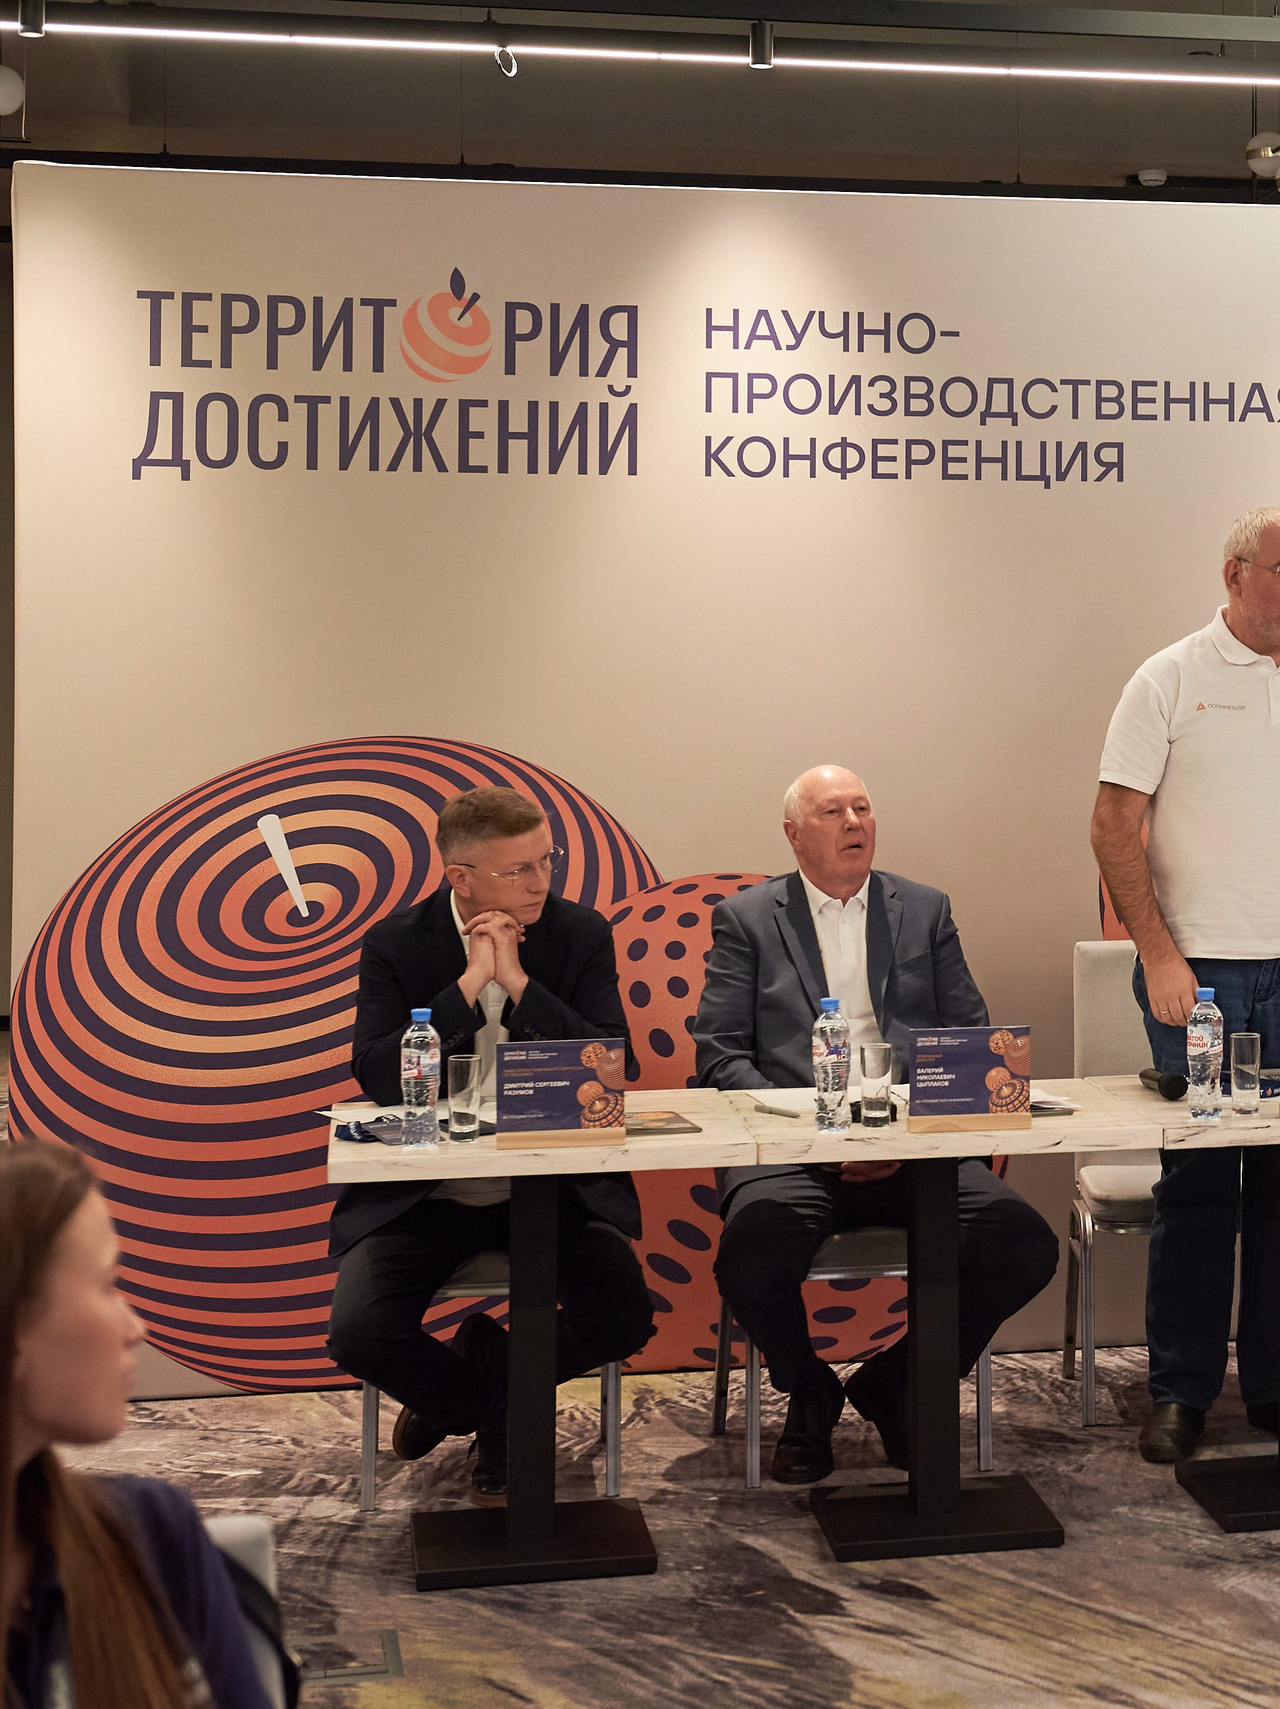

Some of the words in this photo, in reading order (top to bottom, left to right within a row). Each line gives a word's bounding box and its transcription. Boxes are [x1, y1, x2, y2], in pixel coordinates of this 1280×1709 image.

[705, 307, 960, 354] НАУЧНО-
[132, 384, 638, 481] ДОСТИЖЕНИЙ
[705, 436, 1125, 490] КОНФЕРЕНЦИЯ
[1207, 703, 1246, 711] ПОЛИМЕТАЛЛ
[503, 1081, 535, 1090] ДМИТРИЙ
[535, 1080, 571, 1088] СЕРГЕЕВИЧ
